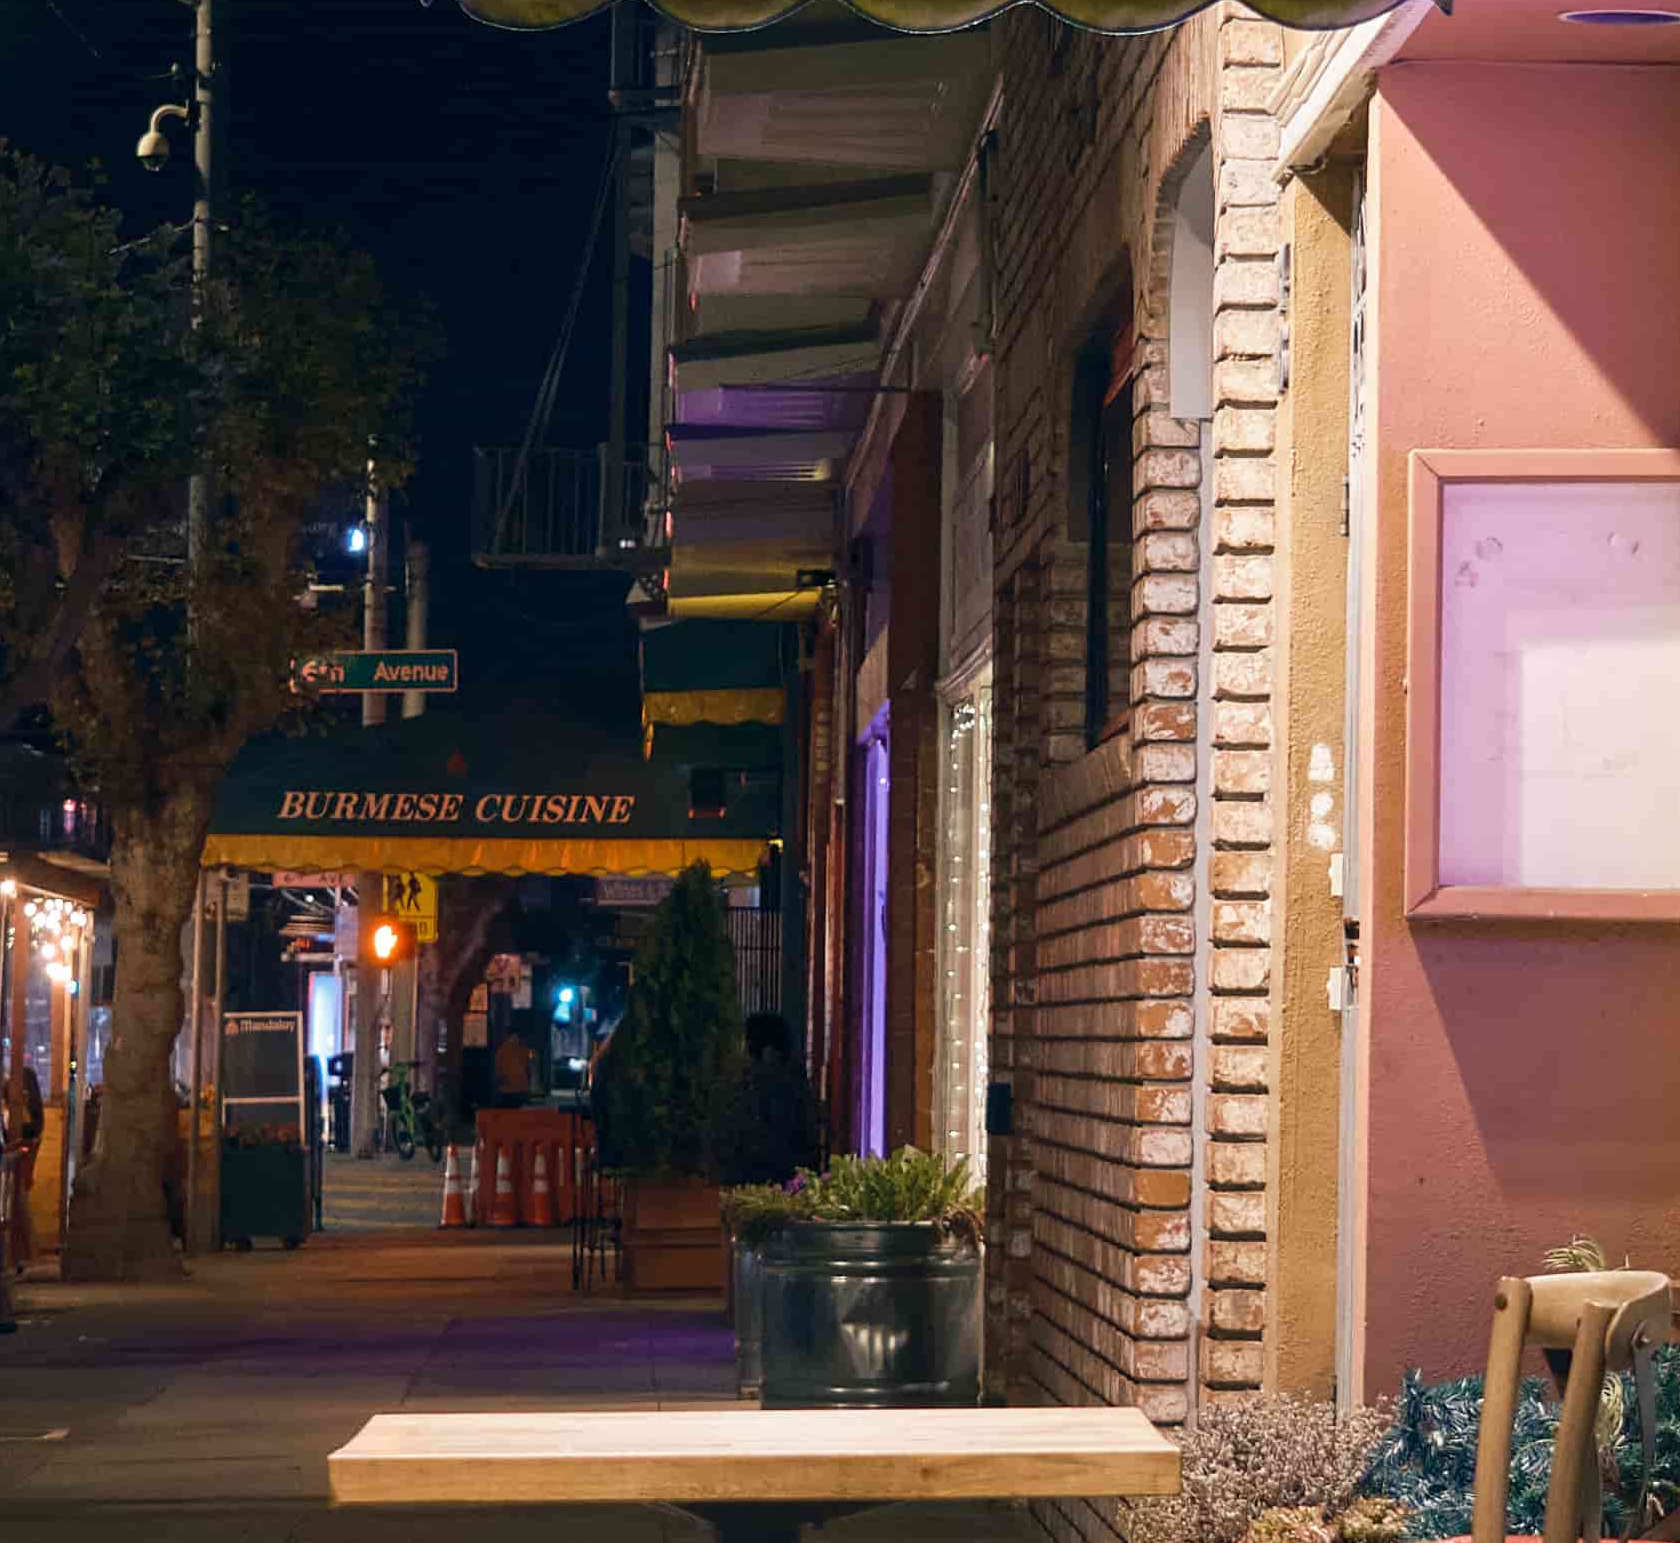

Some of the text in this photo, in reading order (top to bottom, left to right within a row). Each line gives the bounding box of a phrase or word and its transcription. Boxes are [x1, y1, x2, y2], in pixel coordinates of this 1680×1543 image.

[373, 660, 449, 681] Avenue
[276, 790, 635, 824] BURMESE CUISINE
